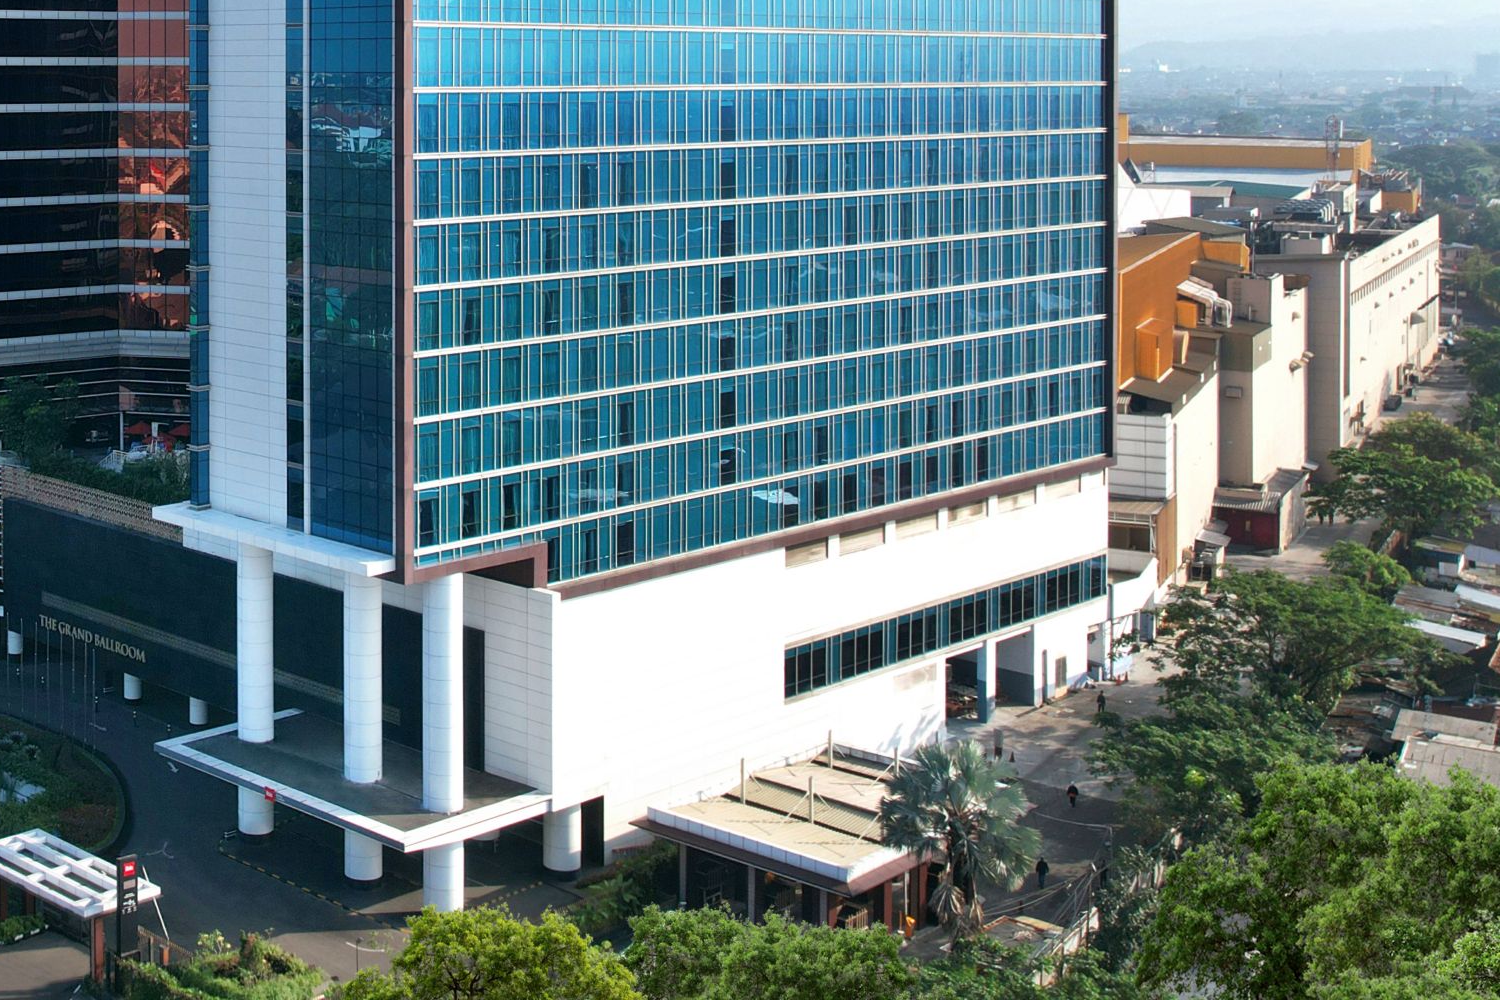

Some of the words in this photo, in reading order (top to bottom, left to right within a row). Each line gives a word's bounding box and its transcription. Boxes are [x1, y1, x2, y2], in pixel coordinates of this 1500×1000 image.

[39, 614, 57, 631] THE
[58, 622, 93, 643] GRAND
[94, 634, 146, 664] BALLROOM
